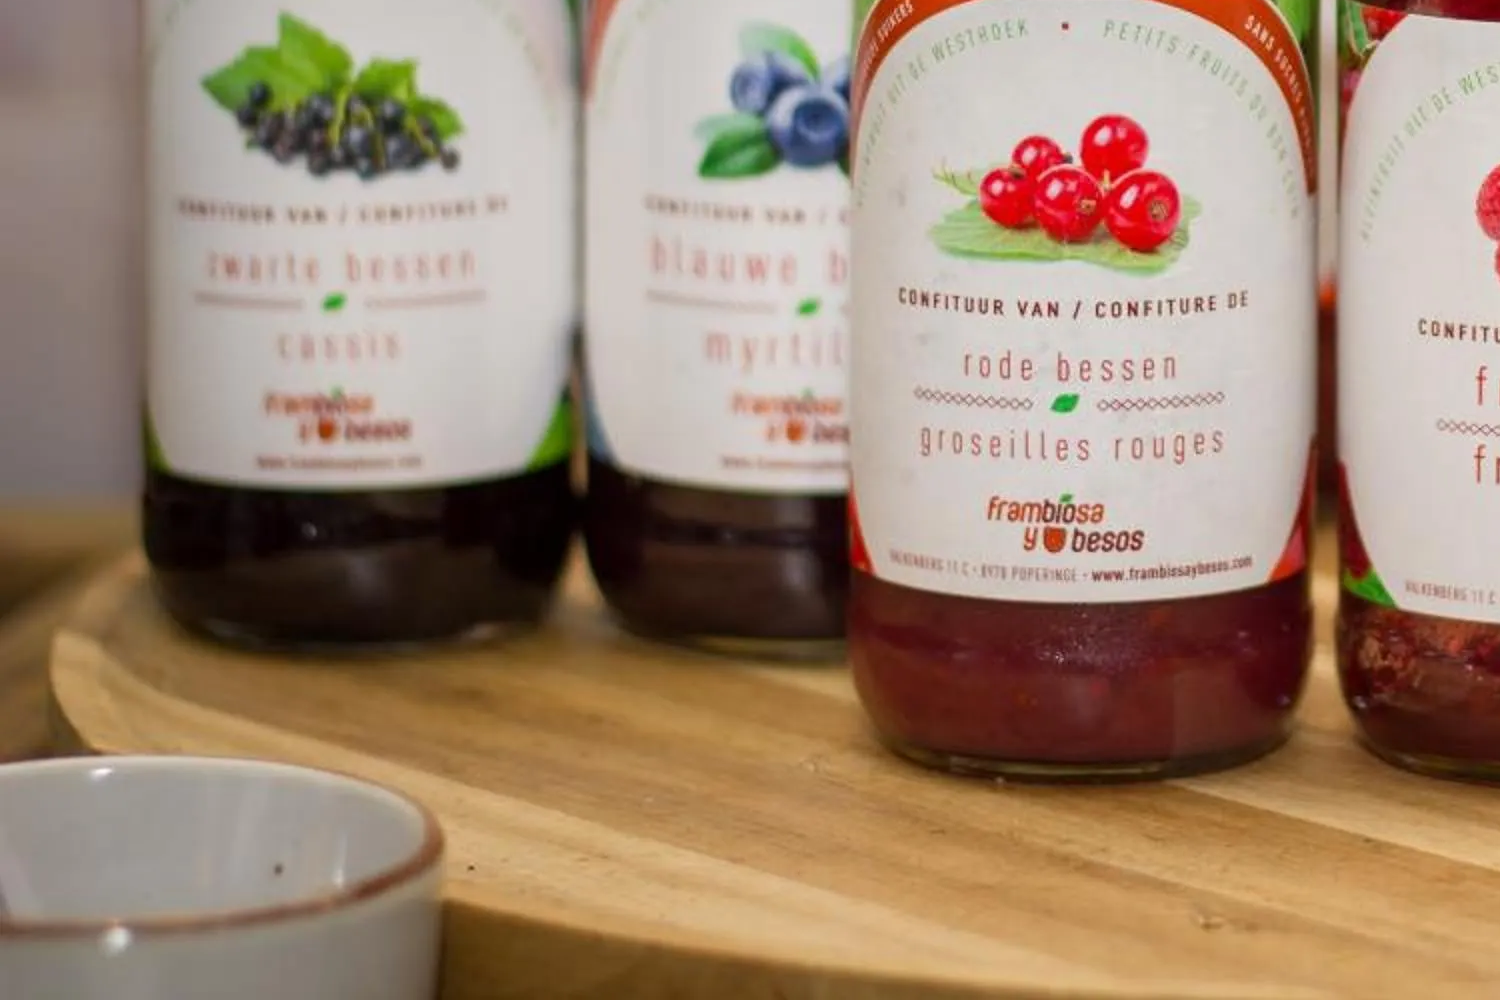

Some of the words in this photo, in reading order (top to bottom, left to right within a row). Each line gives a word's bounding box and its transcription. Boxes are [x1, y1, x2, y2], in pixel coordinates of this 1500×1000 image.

[1244, 15, 1275, 51] SANS
[1103, 19, 1179, 55] PETITS
[1187, 42, 1249, 98] FRUITS
[1432, 86, 1453, 114] DE
[898, 287, 1004, 316] CONFITUUR
[1018, 301, 1060, 319] VAN
[1072, 301, 1081, 320] /
[1094, 295, 1217, 319] CONFITURE
[1226, 291, 1249, 309] DE
[706, 331, 848, 375] myrtil
[964, 350, 1034, 381] rode
[1057, 352, 1177, 383] bessen
[920, 427, 1090, 462] groseilles
[1113, 428, 1225, 464] rouges
[986, 496, 1105, 523] frambiosa
[1023, 526, 1039, 552] y
[1072, 526, 1144, 553] besos
